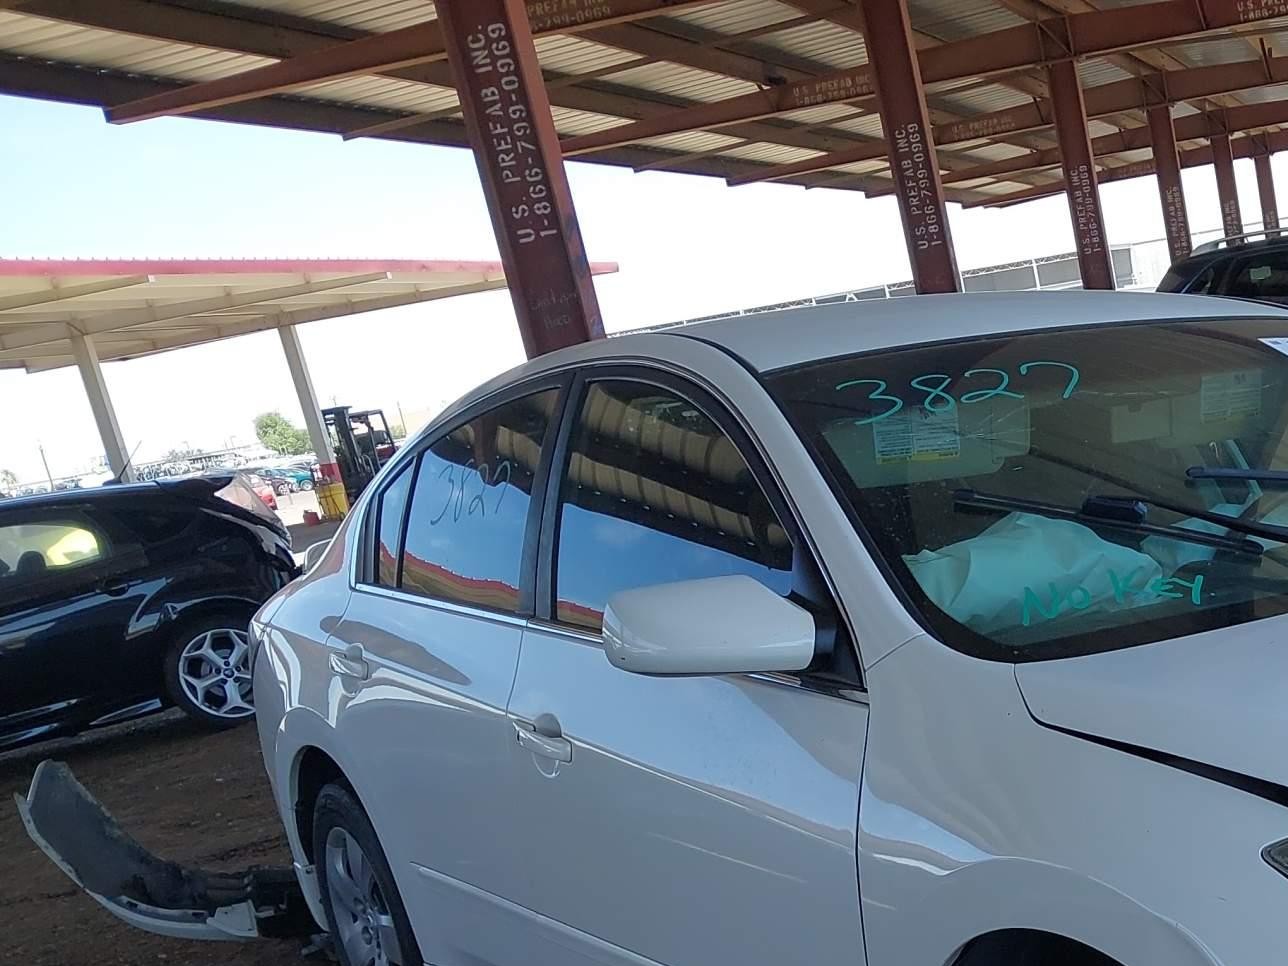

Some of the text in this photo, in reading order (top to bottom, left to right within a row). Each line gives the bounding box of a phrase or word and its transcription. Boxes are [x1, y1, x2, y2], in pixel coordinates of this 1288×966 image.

[467, 25, 536, 244] U.S. PREFAB INC.
[487, 23, 558, 238] 1-866-799-0969
[895, 124, 929, 249] U.S. PREFAB INC.
[907, 123, 942, 246] 1-866-799-0969
[1073, 190, 1088, 230] PREFAB
[835, 361, 1080, 425] 3827
